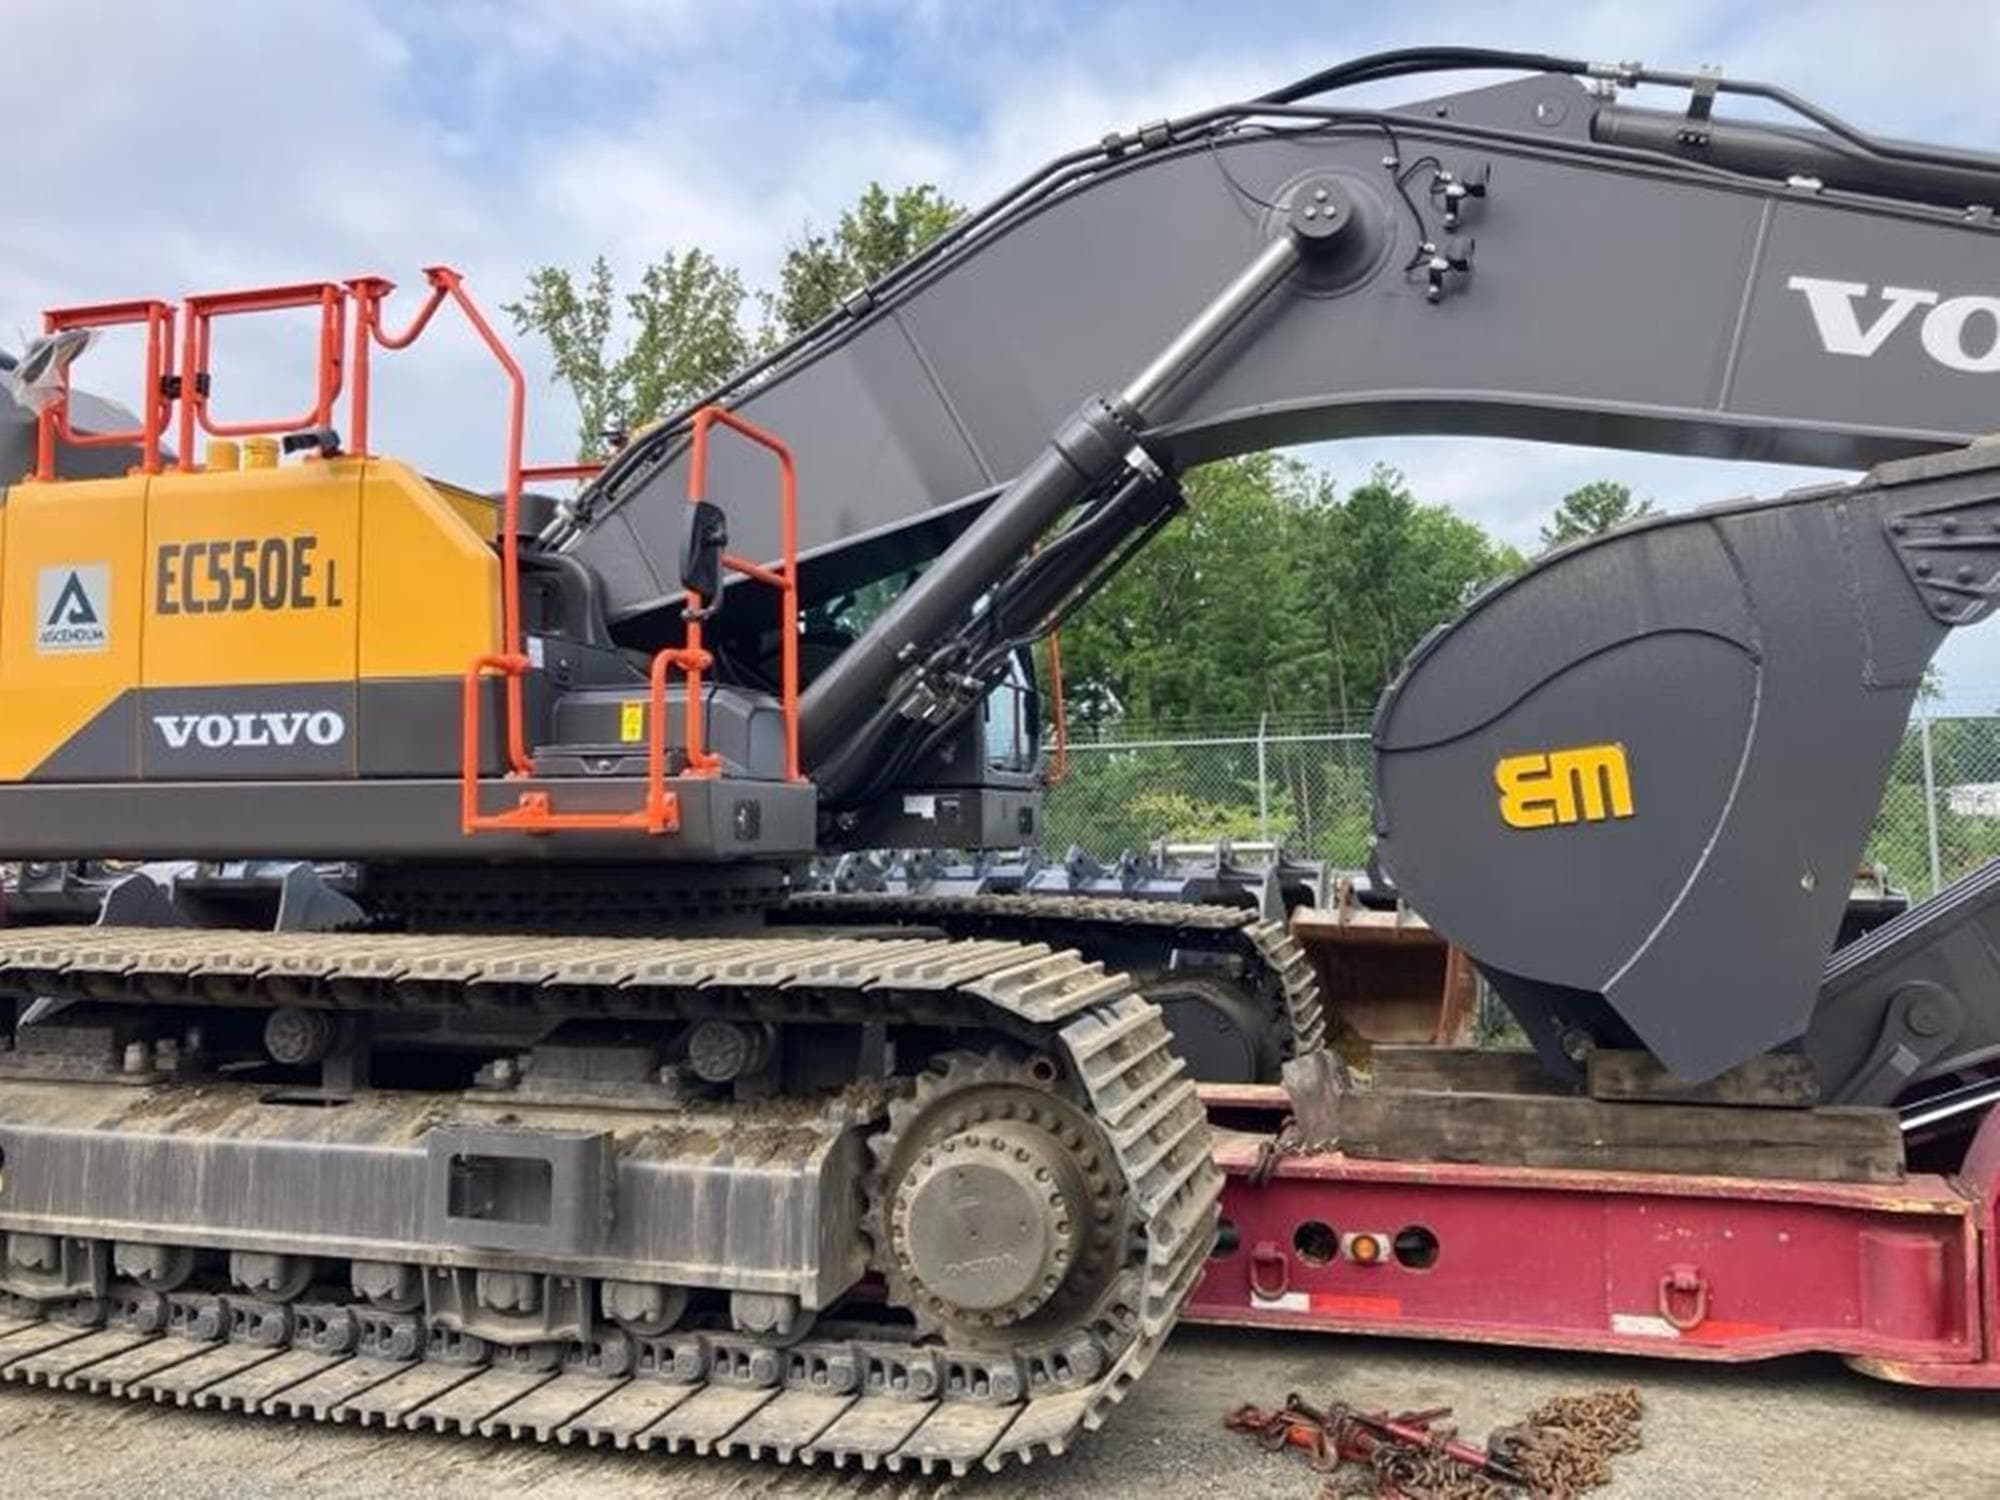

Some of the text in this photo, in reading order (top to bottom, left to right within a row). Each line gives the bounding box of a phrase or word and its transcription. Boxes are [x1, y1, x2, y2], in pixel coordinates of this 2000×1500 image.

[1787, 275, 2000, 373] VO
[156, 536, 343, 615] EC550E L
[154, 710, 345, 748] VOLVO
